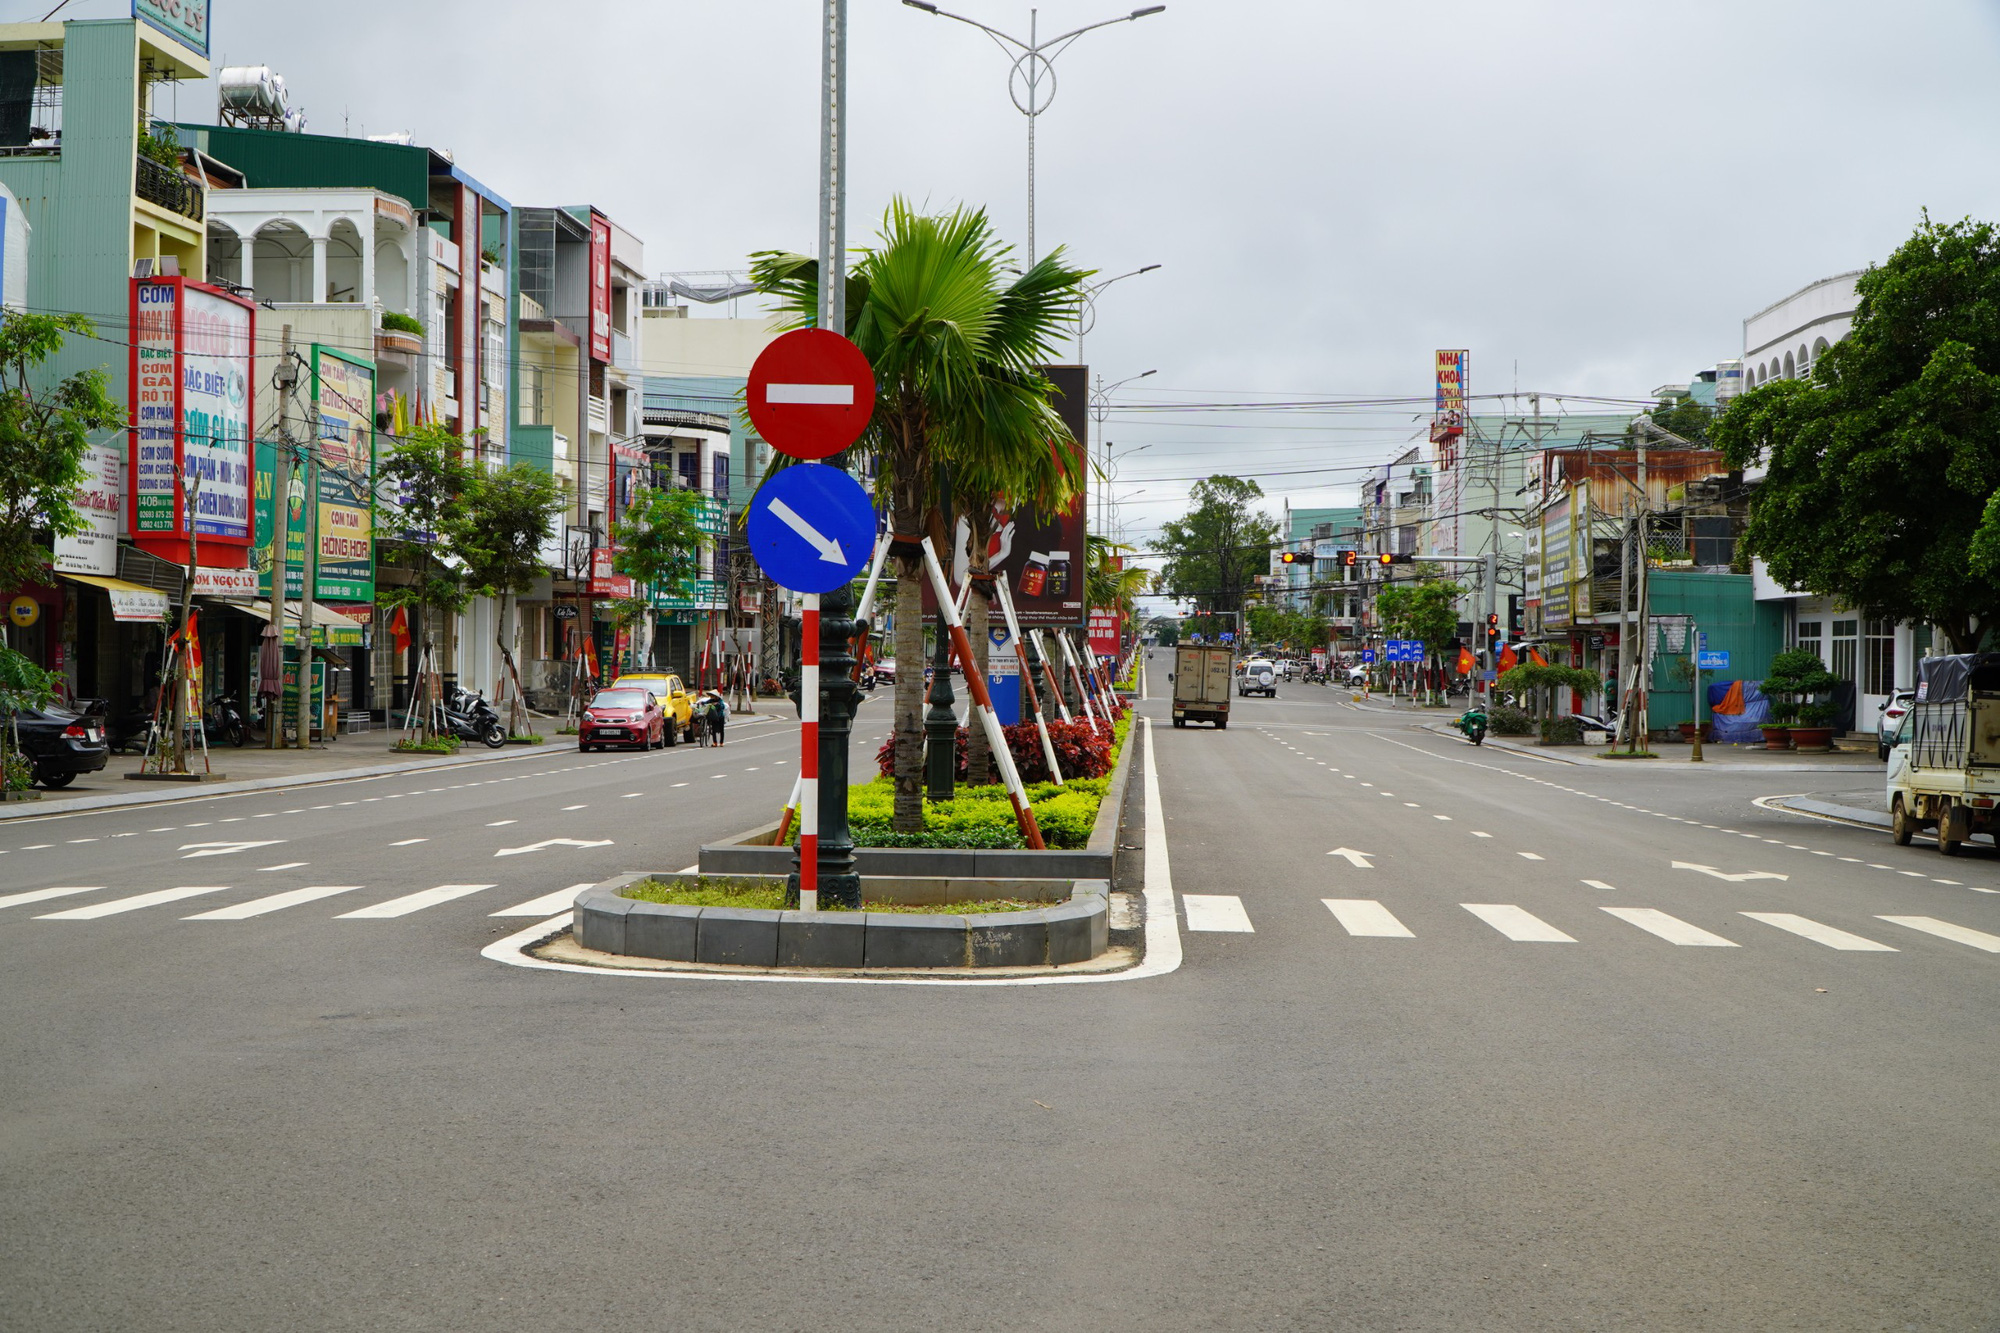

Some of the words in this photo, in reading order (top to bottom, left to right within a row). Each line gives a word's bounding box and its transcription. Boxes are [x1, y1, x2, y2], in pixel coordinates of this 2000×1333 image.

[184, 3, 203, 32] LÝ
[140, 285, 174, 303] CƠM
[1438, 352, 1460, 366] NHA
[141, 363, 172, 375] CƠM
[142, 374, 172, 387] GÀ
[1437, 370, 1461, 383] KHOA
[141, 389, 158, 402] RÔ
[162, 391, 173, 402] TI
[1451, 400, 1462, 408] LAI
[141, 406, 155, 420] CƠM
[141, 427, 156, 440] CƠM
[141, 447, 155, 460] CƠM
[139, 464, 153, 475] CƠM
[138, 496, 158, 507] 140B
[349, 540, 368, 558] HOA
[1347, 551, 1356, 565] 2
[212, 575, 240, 588] NGỌC
[242, 574, 255, 587] LÝ
